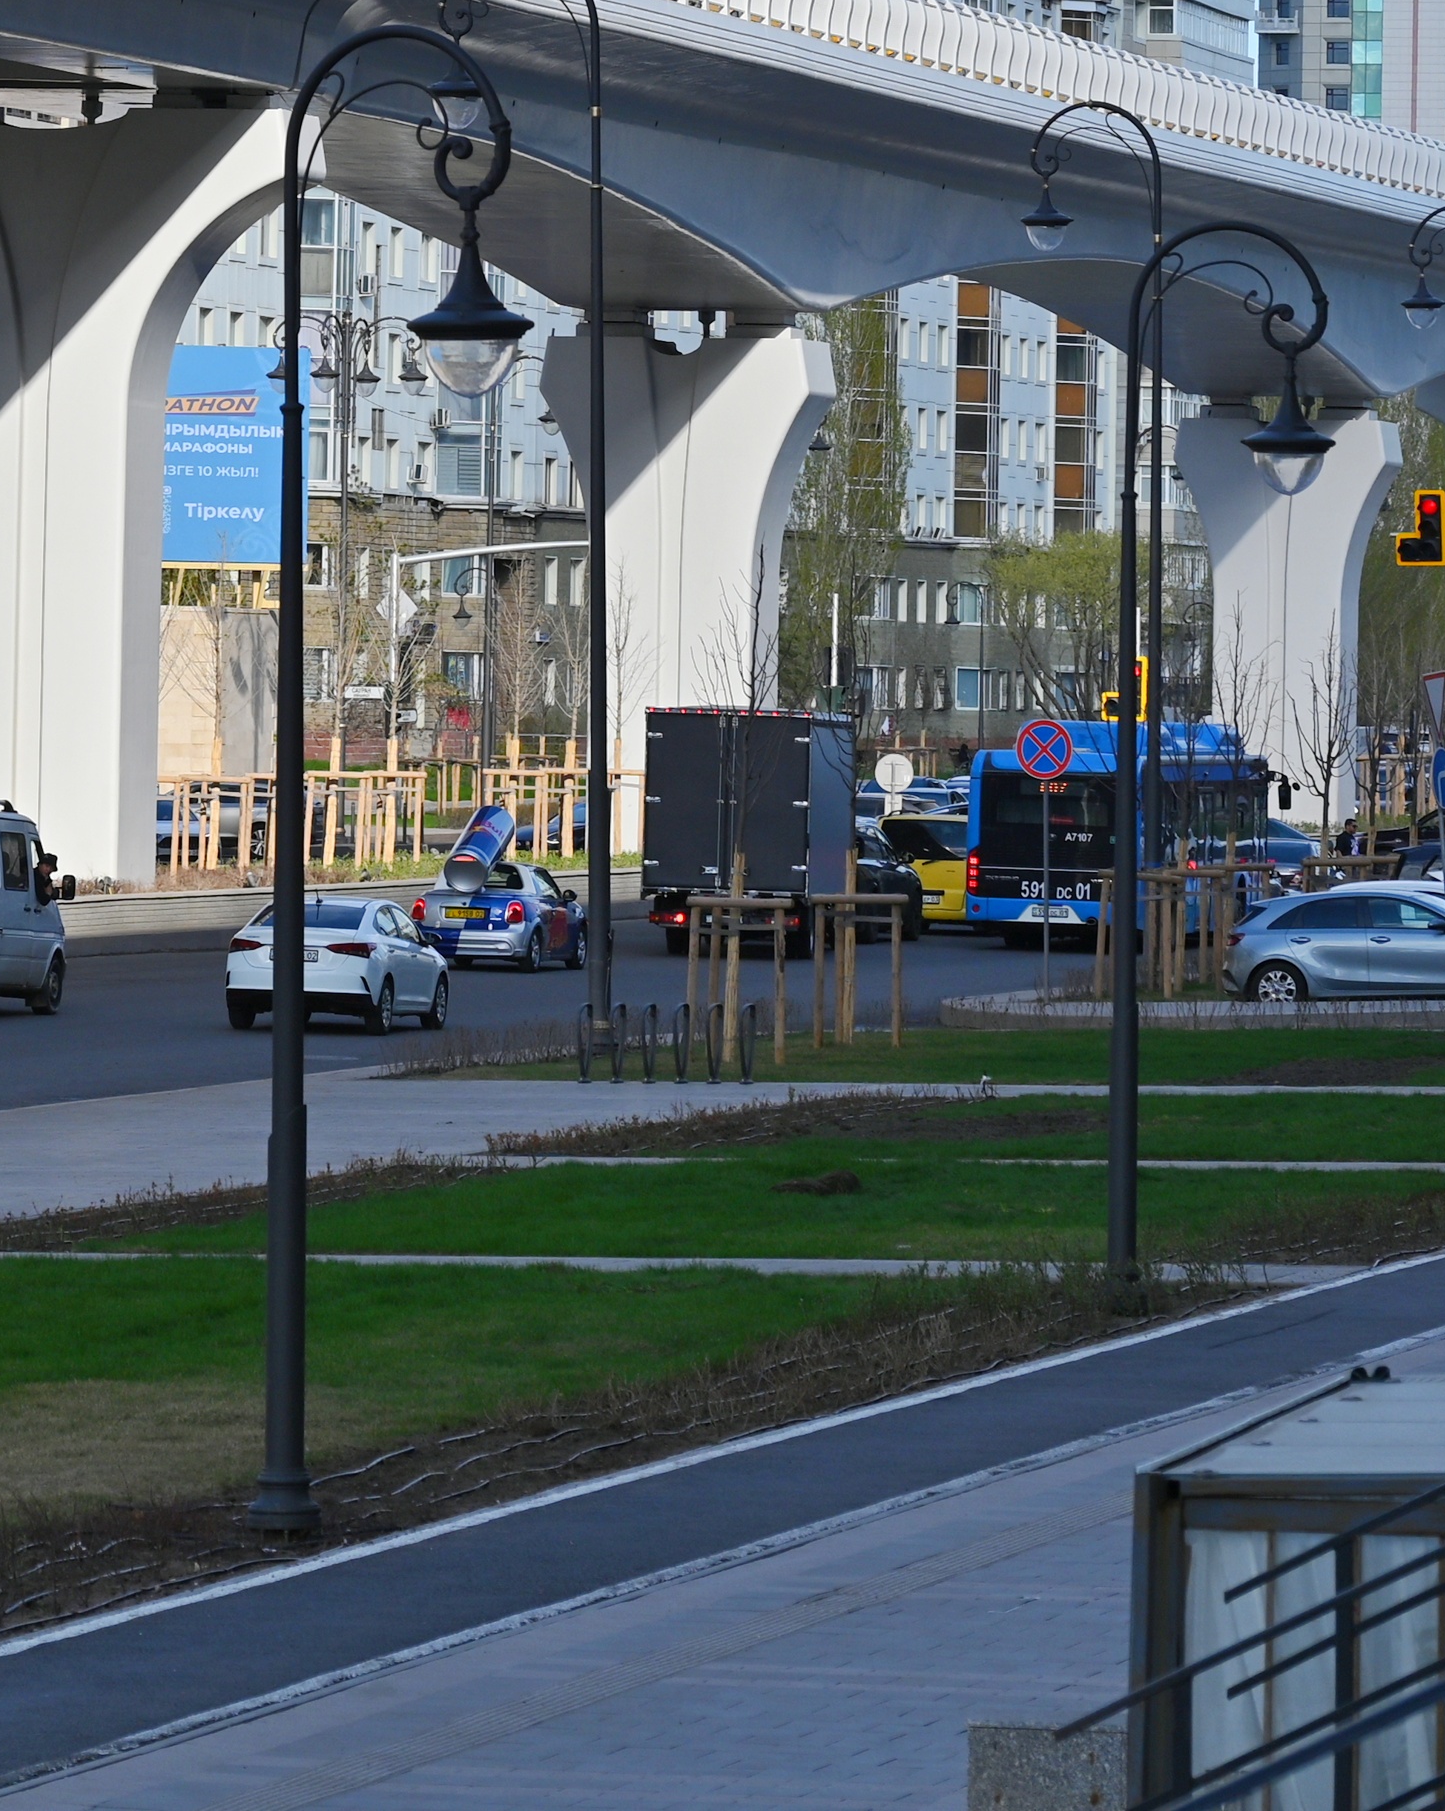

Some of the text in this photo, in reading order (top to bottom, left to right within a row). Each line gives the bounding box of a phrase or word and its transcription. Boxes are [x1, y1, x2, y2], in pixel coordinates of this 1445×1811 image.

[198, 466, 212, 476] 10
[216, 466, 259, 478] ЖЫЛ!
[184, 503, 264, 522] Тіркелу
[1065, 833, 1093, 843] A7107
[1021, 881, 1091, 900] 591 DC 01
